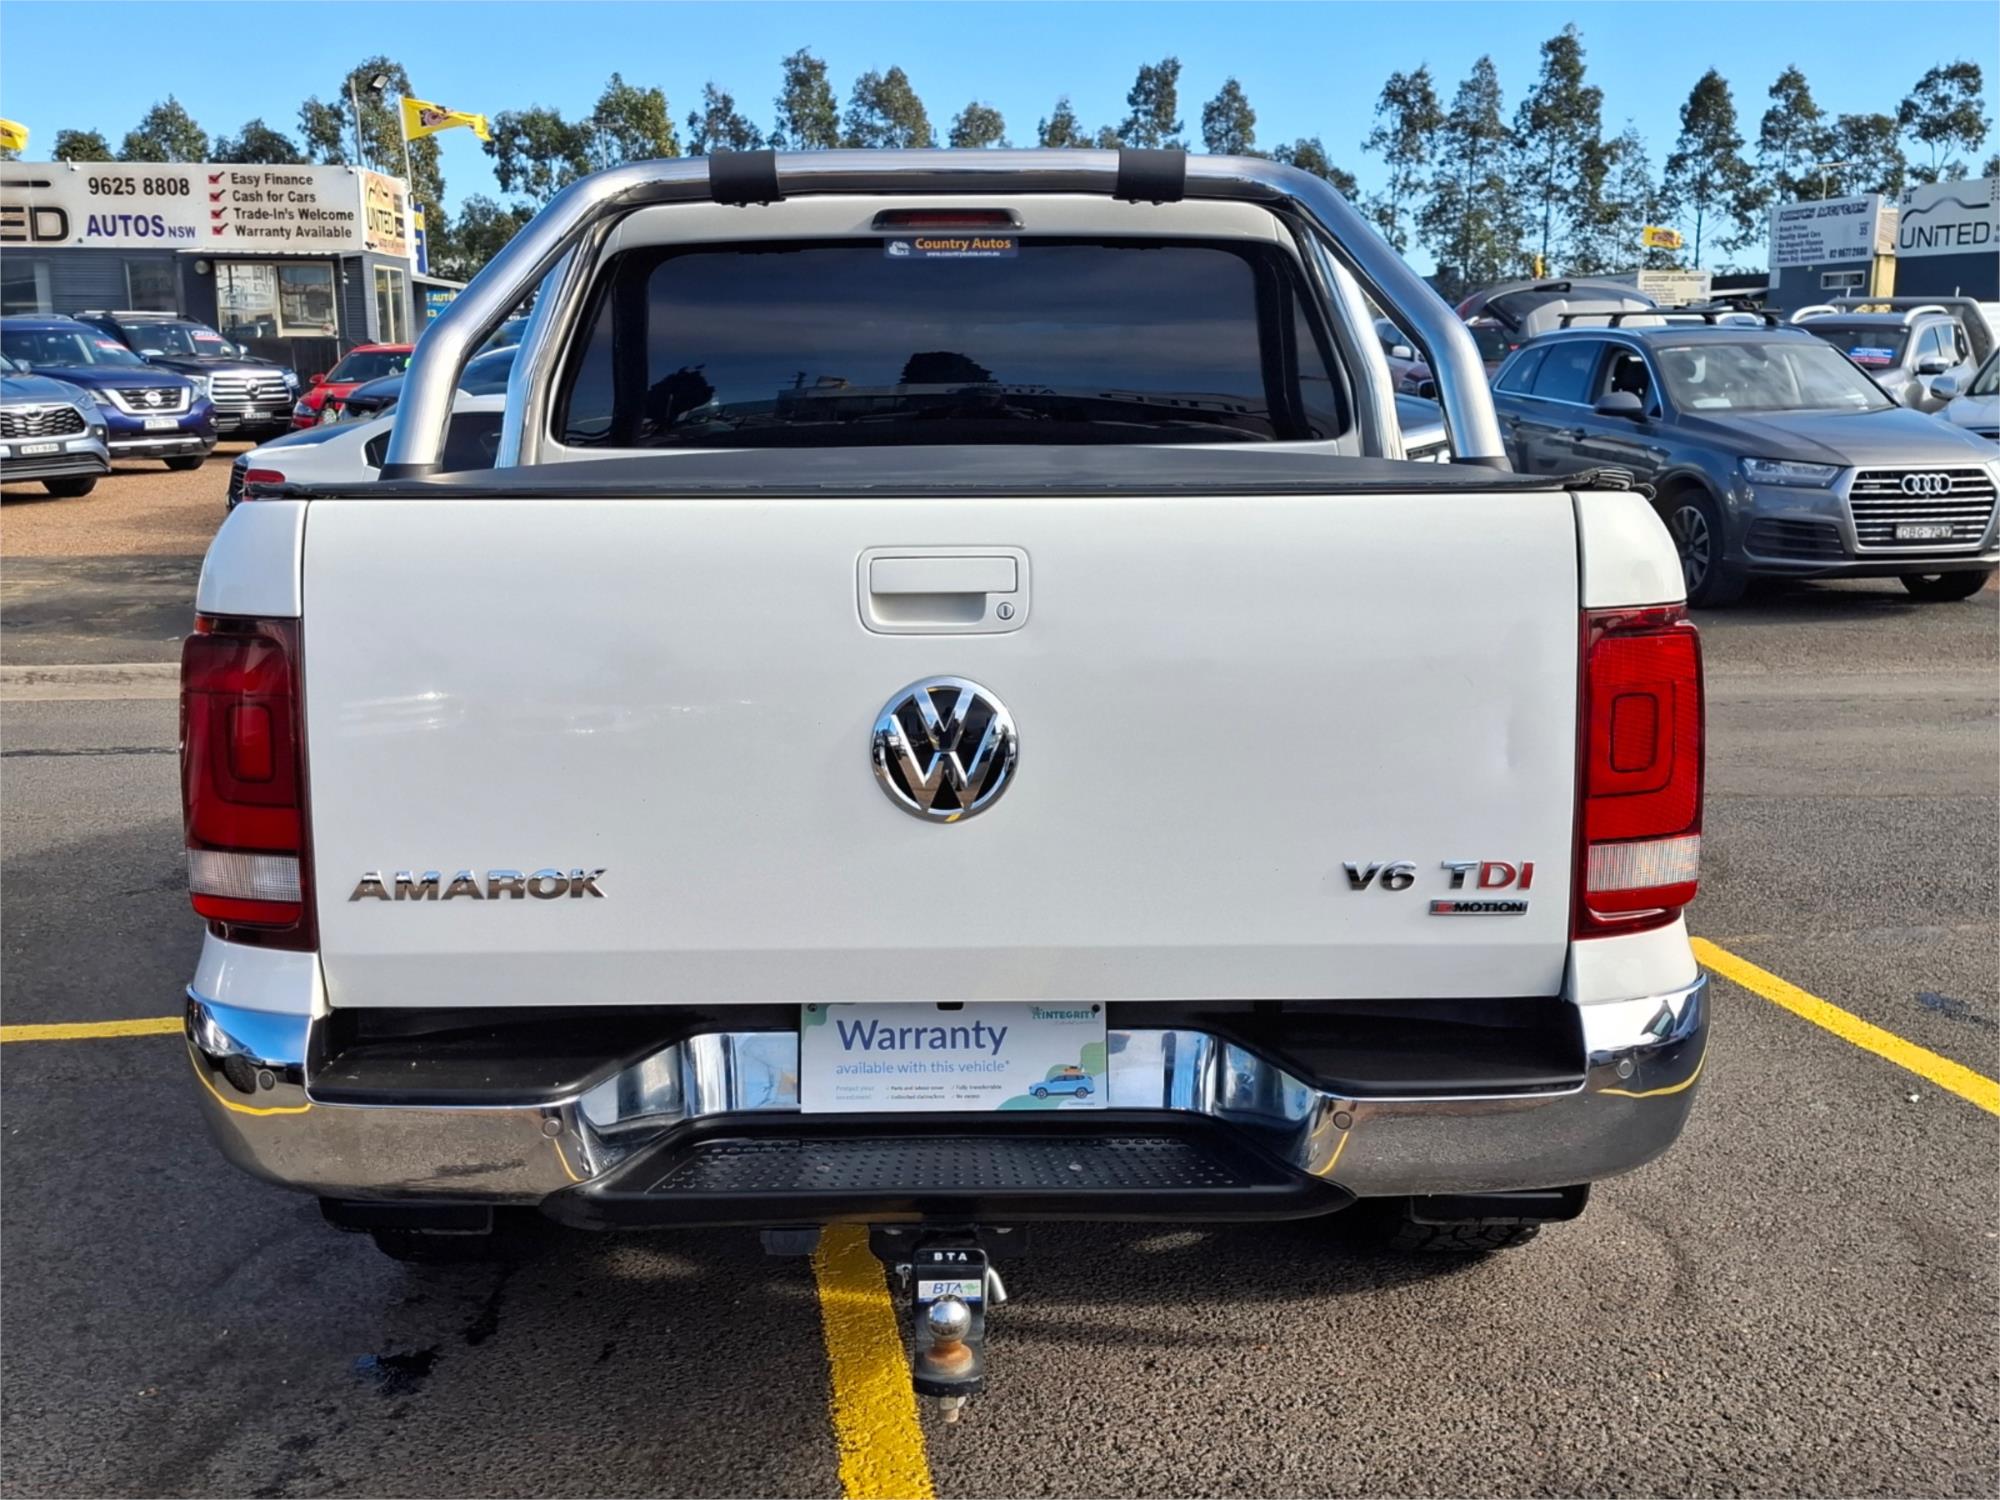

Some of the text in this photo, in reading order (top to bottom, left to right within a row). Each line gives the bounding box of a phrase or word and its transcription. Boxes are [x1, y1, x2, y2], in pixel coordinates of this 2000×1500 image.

[88, 177, 190, 196] 9625 8808
[230, 173, 313, 187] Easy Finance
[232, 190, 316, 203] Cash for Cars
[233, 207, 354, 220] Trade-In's Welcome
[86, 215, 196, 238] AUTOS NSW
[235, 225, 352, 240] Warranty Available
[914, 238, 1012, 251] Country Autos
[1342, 860, 1535, 891] V6 TDI
[349, 869, 608, 902] AMAROK
[836, 1018, 1008, 1056] Warranty
[836, 1062, 894, 1074] available
[898, 1061, 927, 1072] with
[931, 1060, 955, 1072] this
[934, 1252, 968, 1261] BTA
[932, 1282, 963, 1295] BTA
